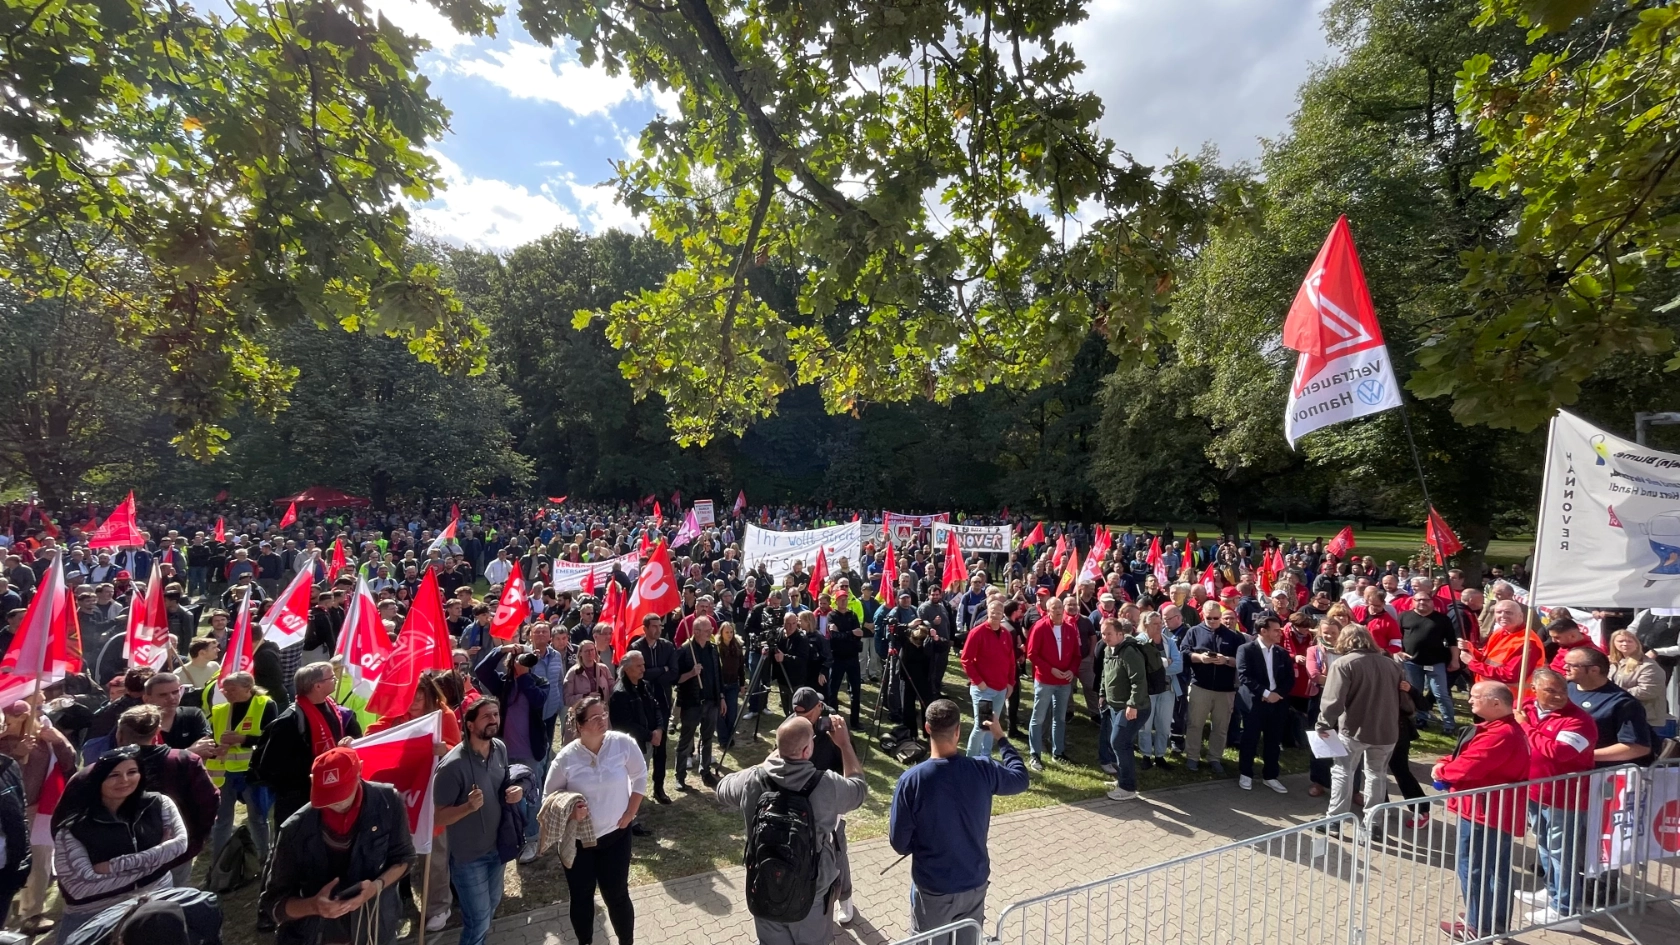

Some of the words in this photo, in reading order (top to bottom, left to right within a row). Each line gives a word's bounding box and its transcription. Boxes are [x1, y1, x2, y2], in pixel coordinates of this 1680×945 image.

[757, 529, 780, 547] Ihr
[936, 528, 1003, 551] HNOVER
[782, 552, 809, 571] sid
